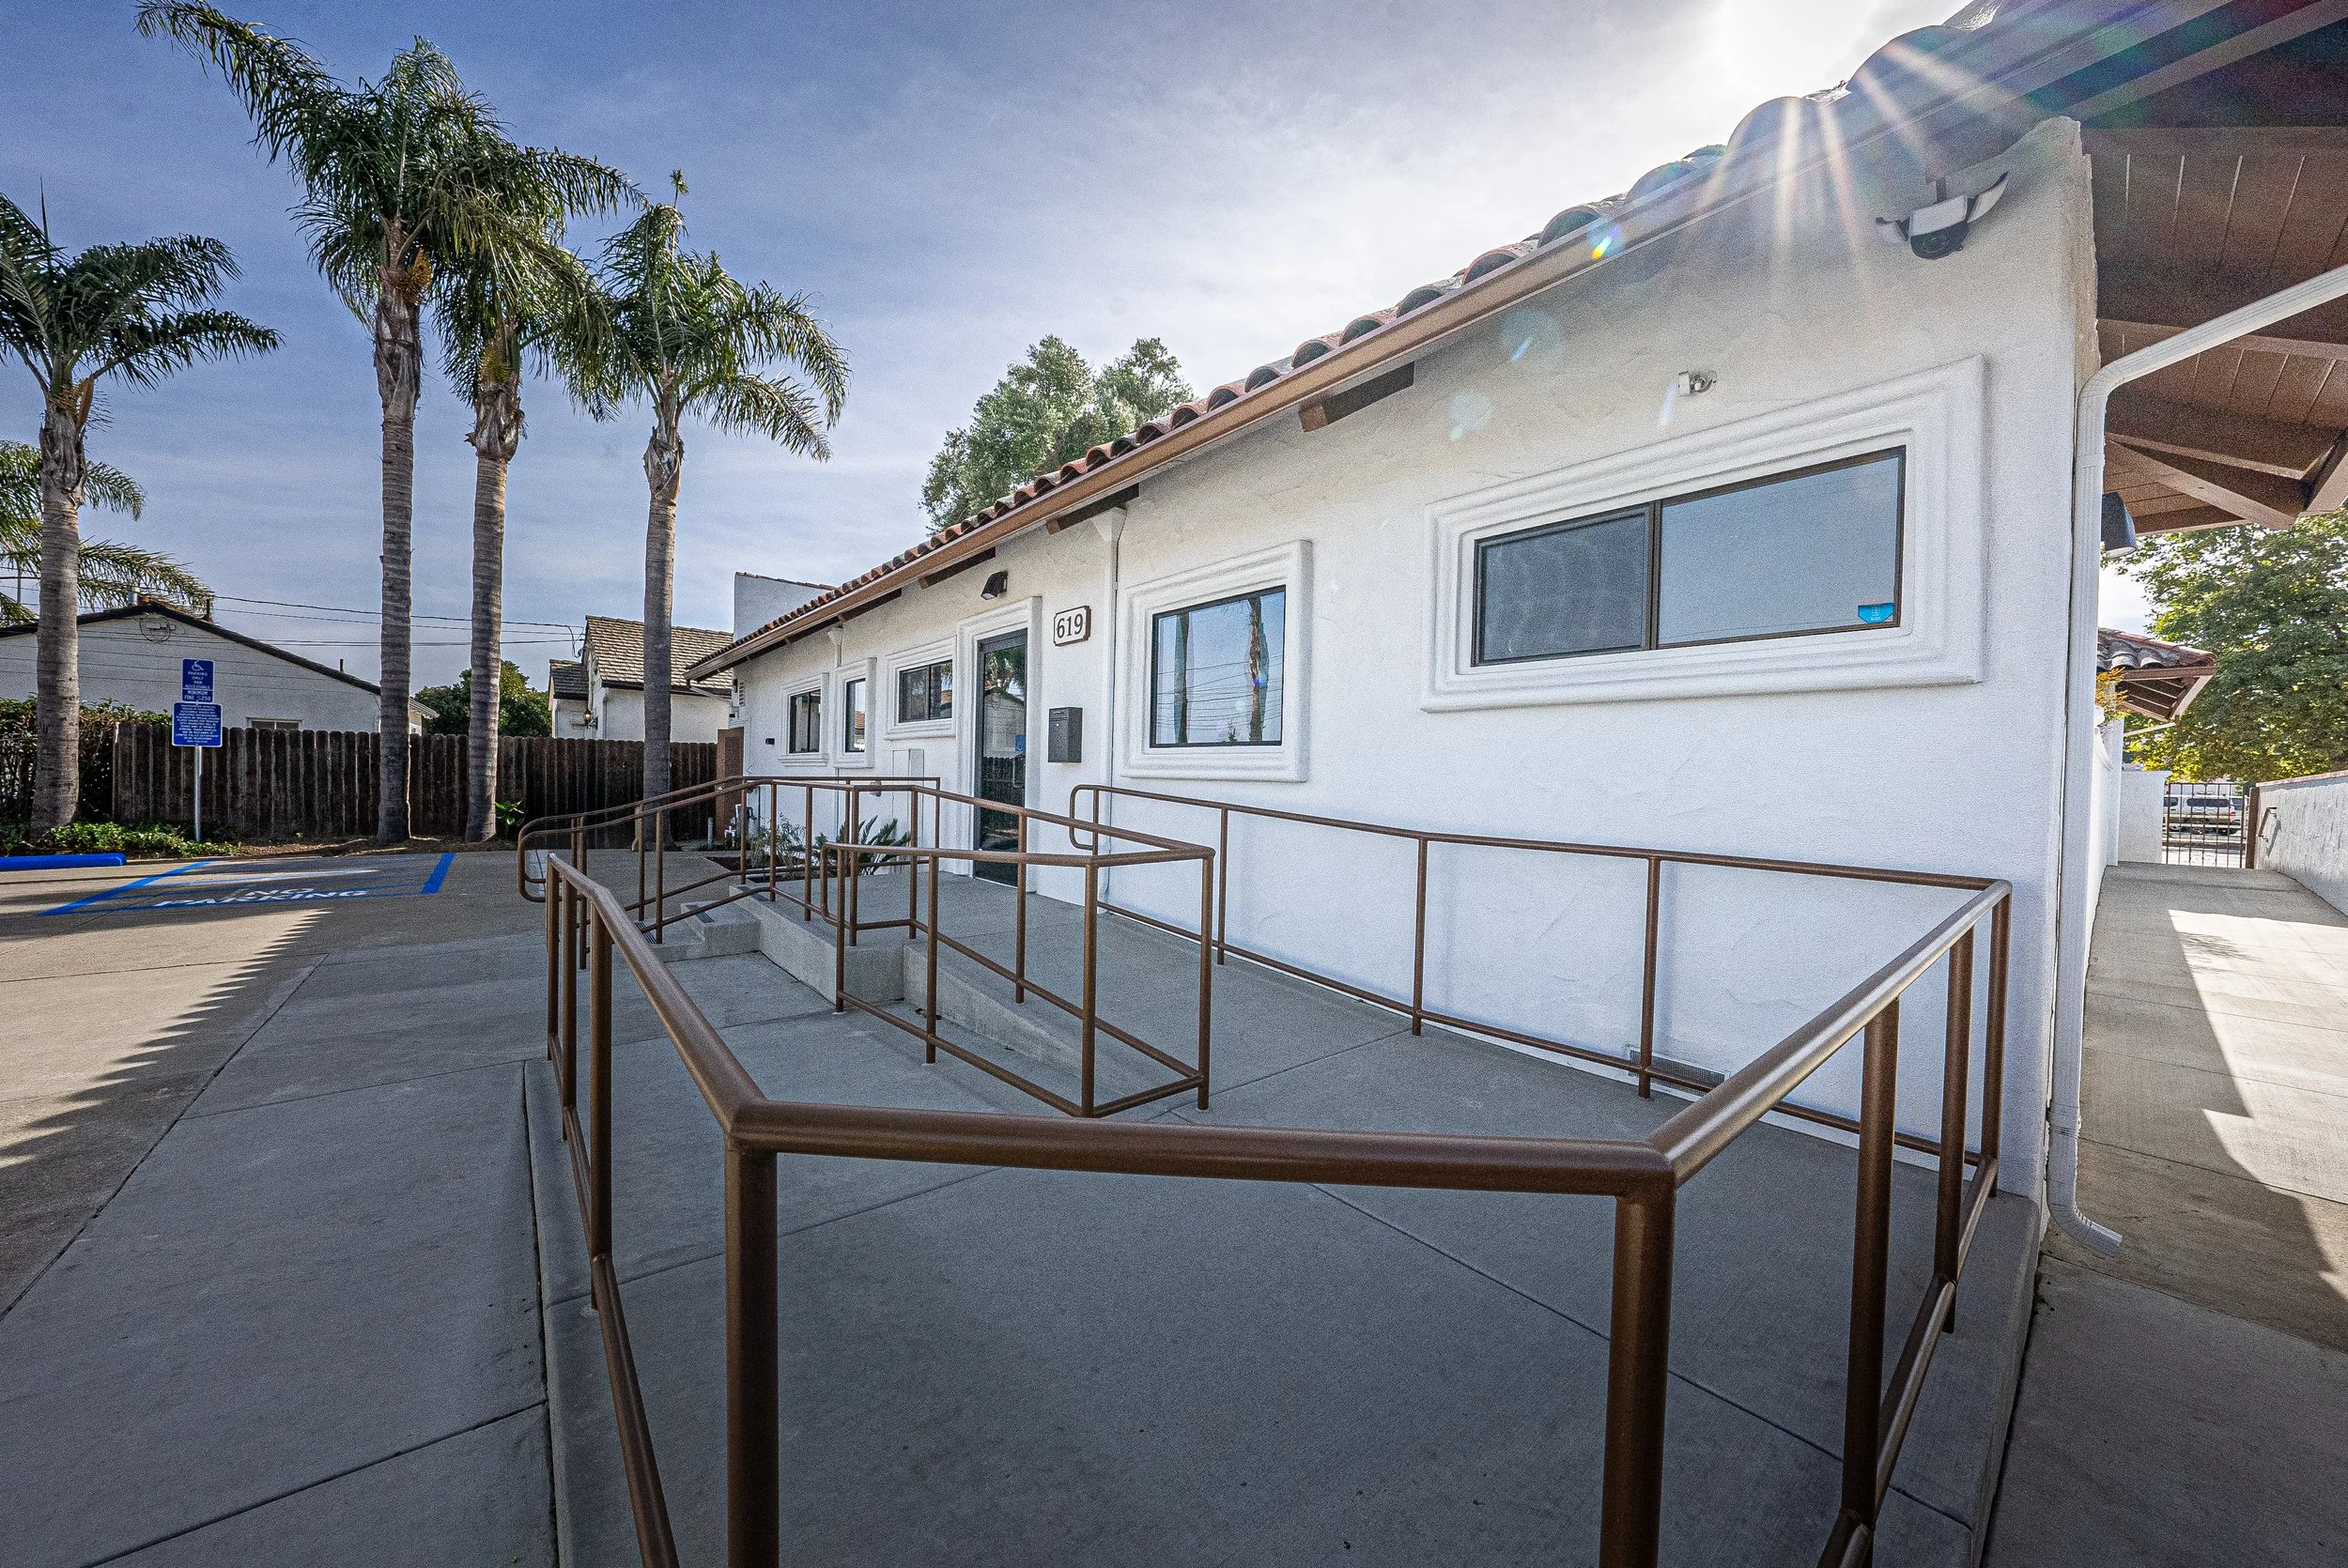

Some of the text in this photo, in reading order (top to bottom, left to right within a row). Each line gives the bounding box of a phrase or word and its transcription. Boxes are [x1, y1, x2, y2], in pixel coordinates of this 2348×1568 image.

[1057, 613, 1083, 638] 619
[152, 890, 367, 907] PARKING
[245, 887, 315, 897] NO
